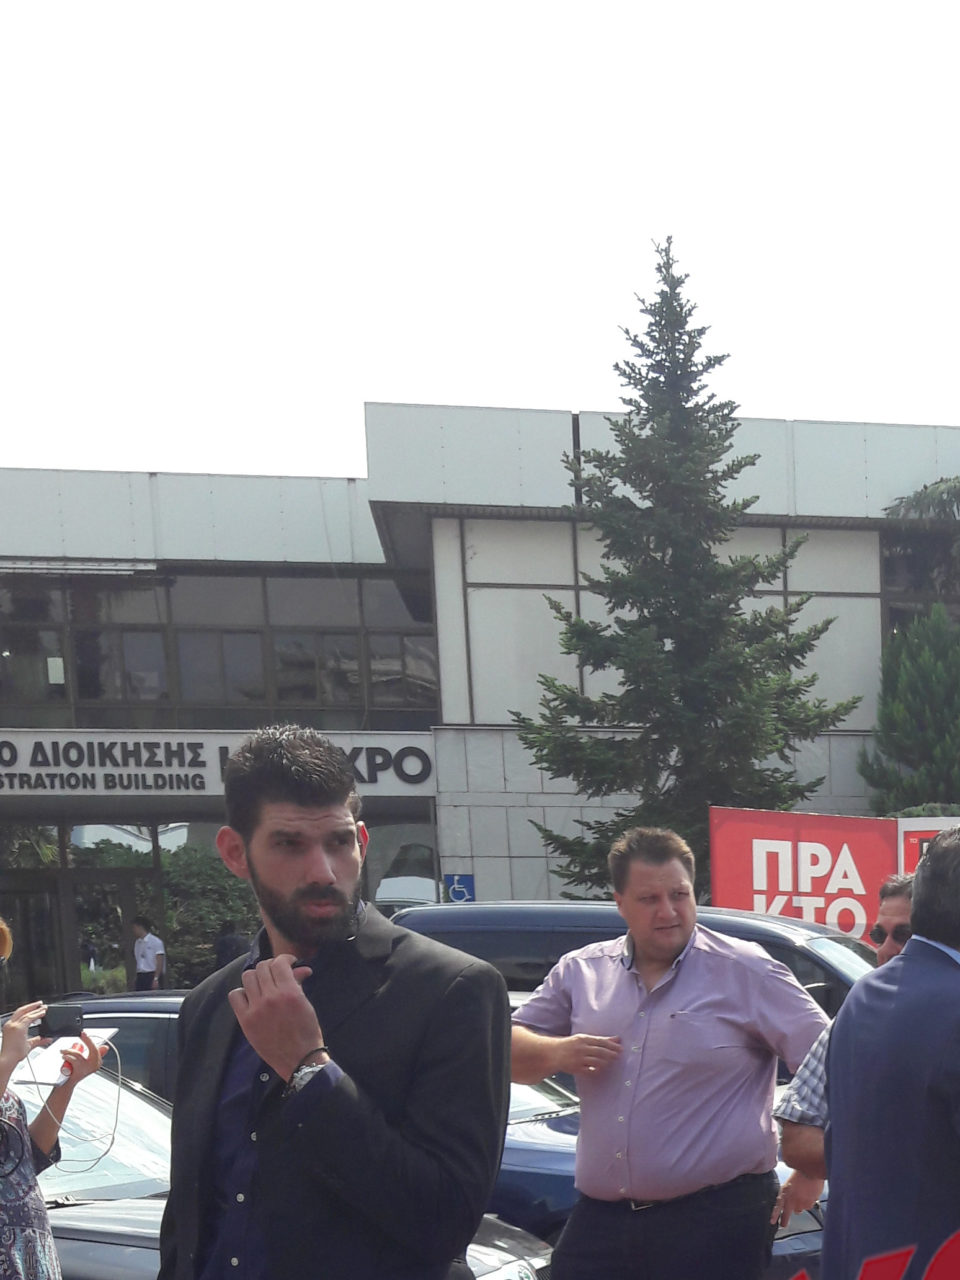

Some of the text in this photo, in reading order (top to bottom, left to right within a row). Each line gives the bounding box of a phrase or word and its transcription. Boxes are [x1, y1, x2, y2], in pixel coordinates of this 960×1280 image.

[29, 741, 207, 768] ΔΙΟΙΚΗΣΗΣ
[0, 772, 206, 790] TRATION BUILDING
[752, 839, 867, 895] ΠΡΑ
